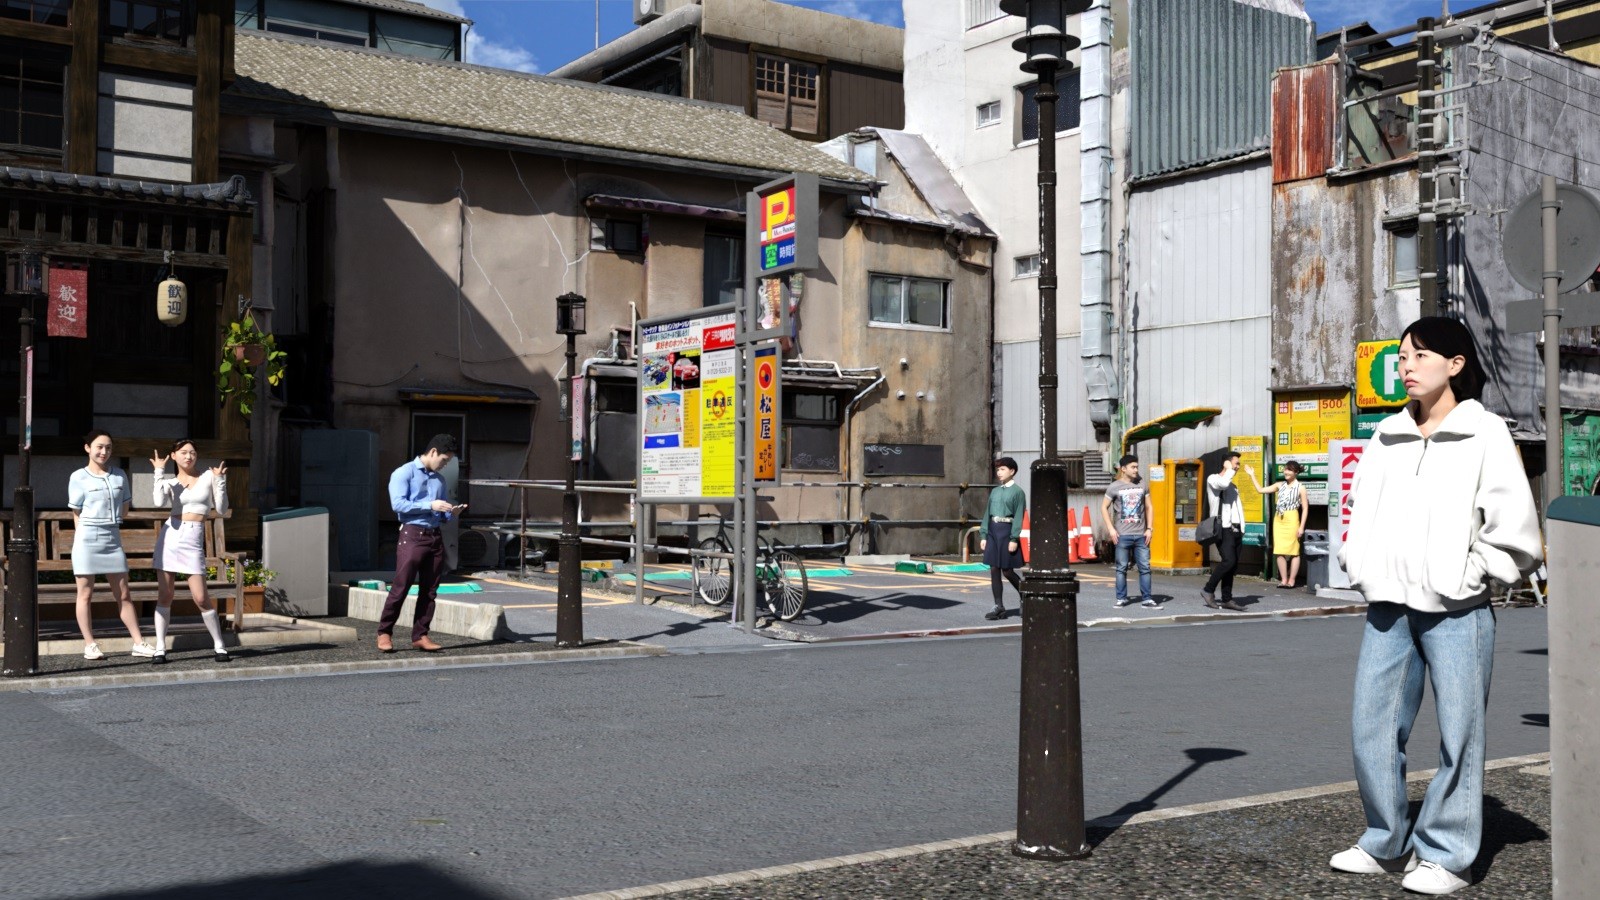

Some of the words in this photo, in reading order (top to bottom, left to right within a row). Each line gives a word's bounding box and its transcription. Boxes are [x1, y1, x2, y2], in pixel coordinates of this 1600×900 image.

[767, 191, 789, 241] P
[766, 243, 777, 268] 空
[58, 285, 77, 322] 歓迎
[168, 284, 181, 315] 歓迎
[1359, 346, 1374, 358] 24h
[1359, 395, 1377, 405] Repark
[760, 394, 772, 439] 松屋
